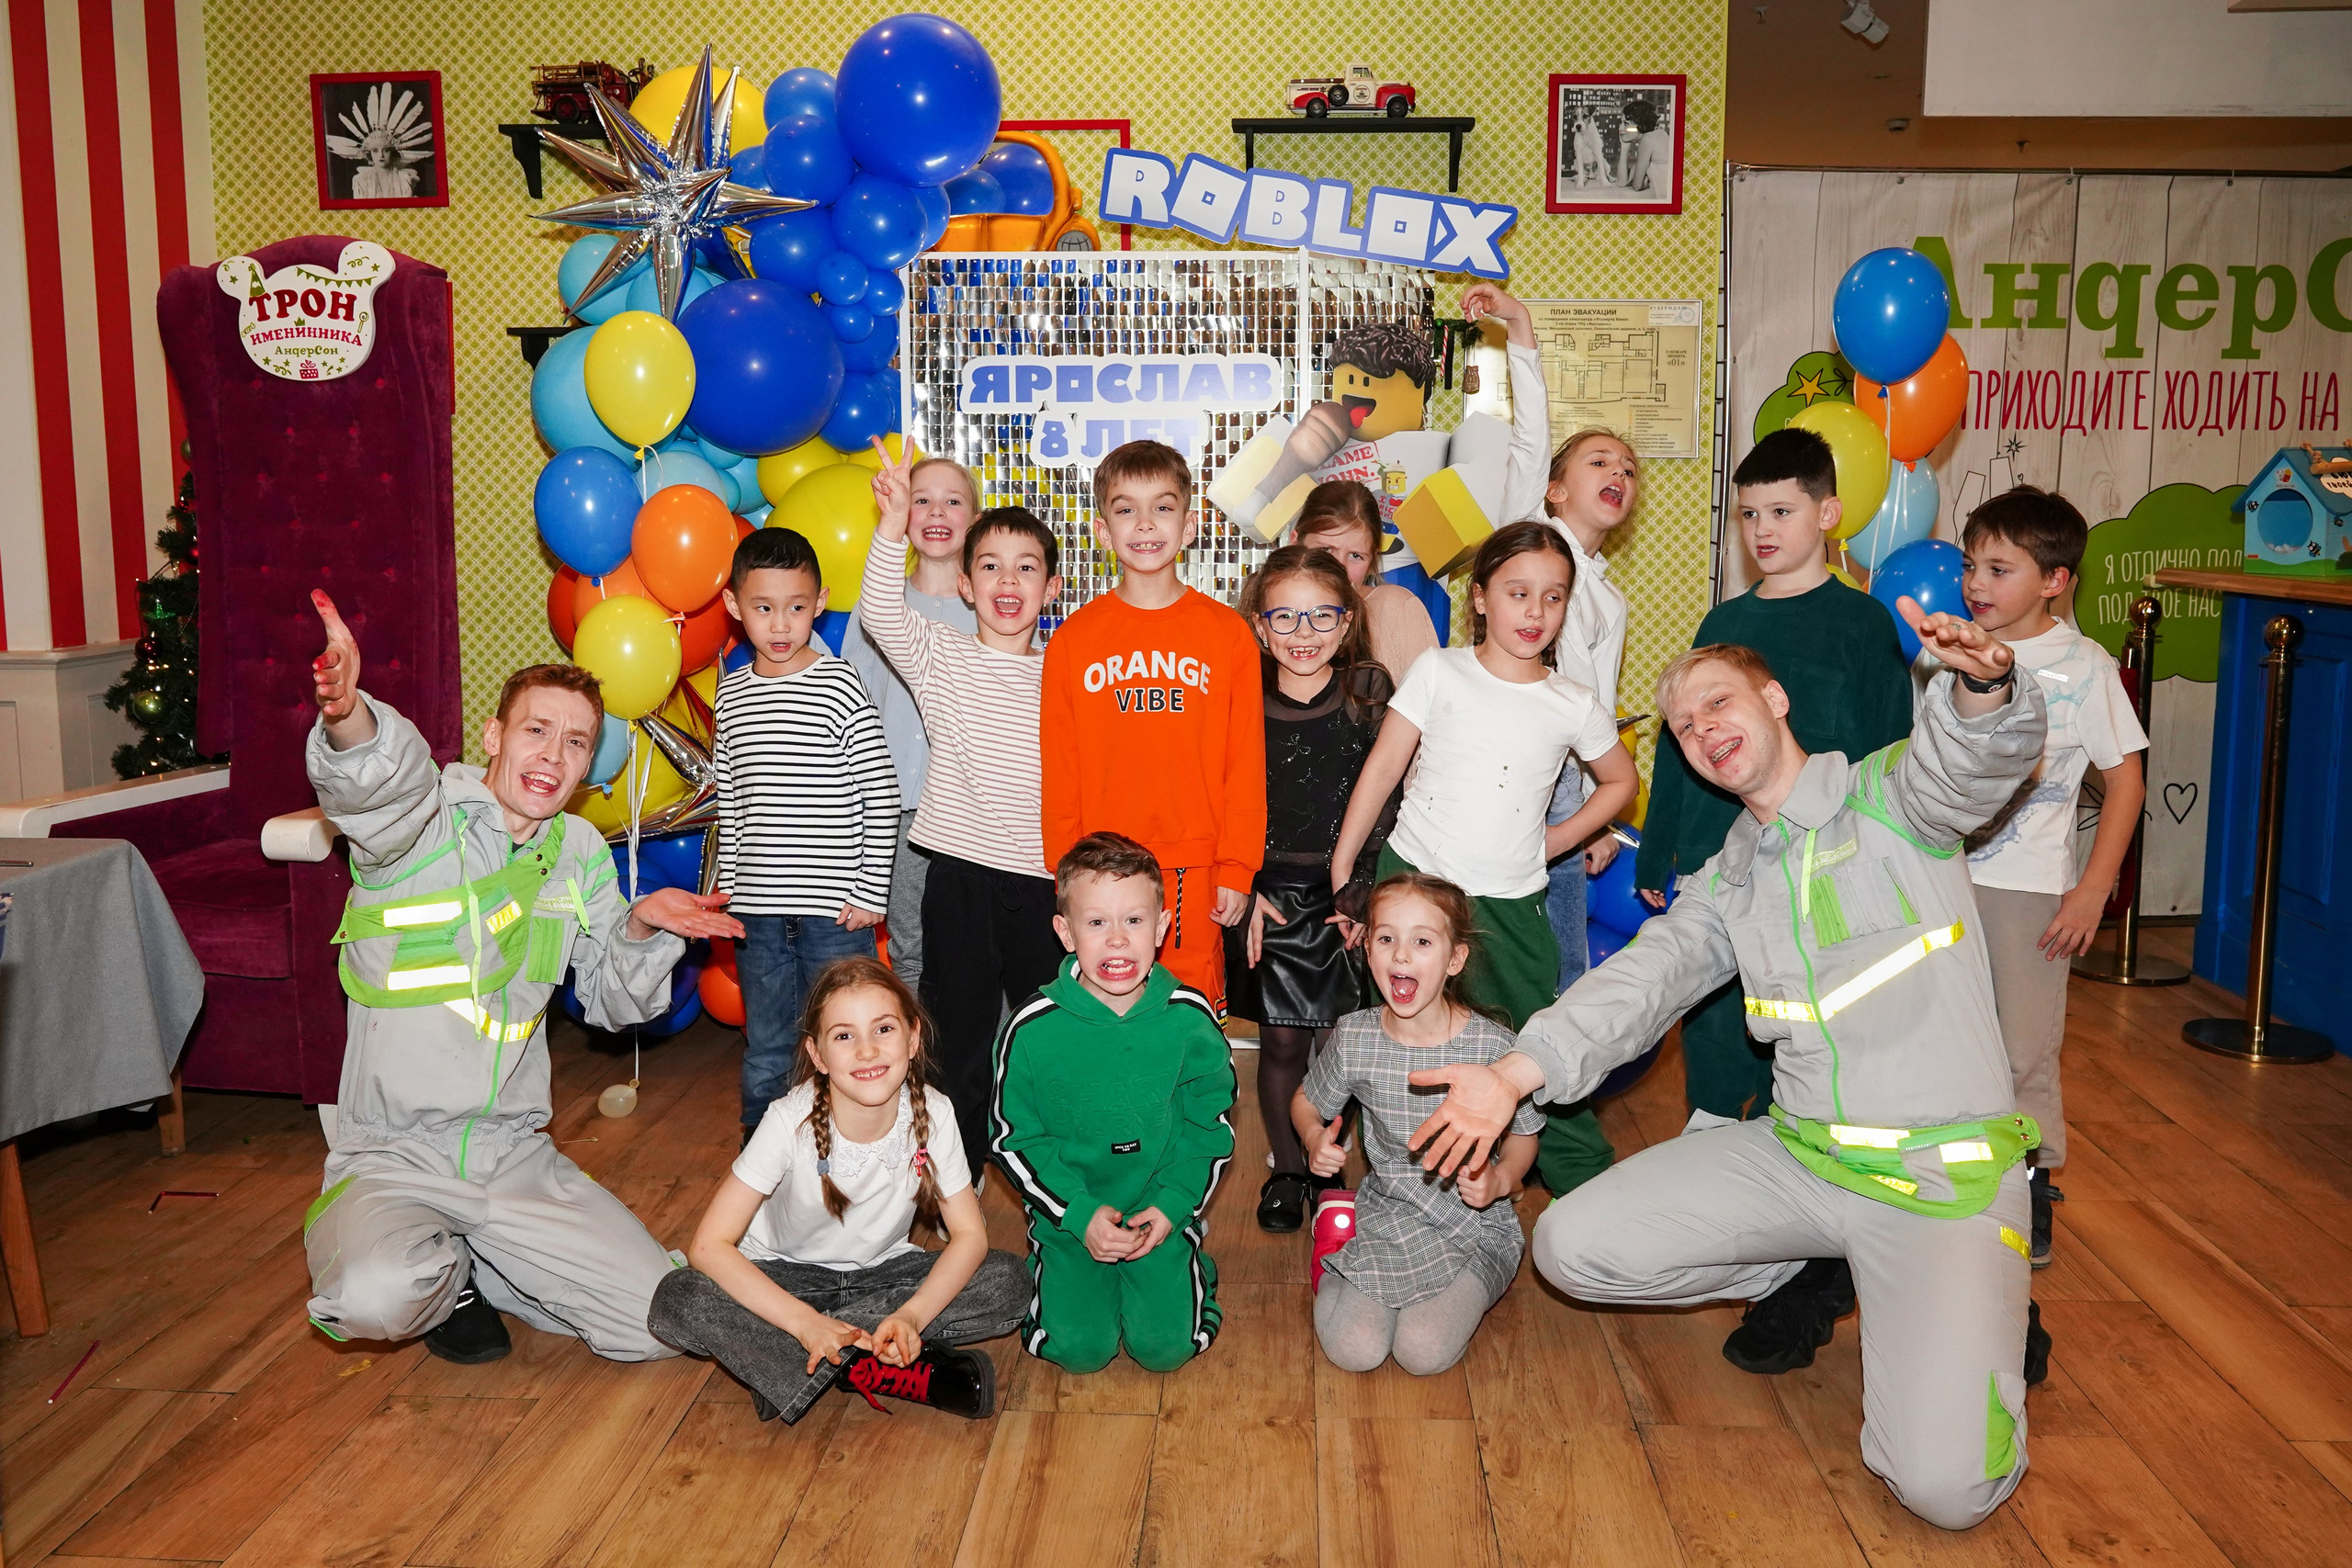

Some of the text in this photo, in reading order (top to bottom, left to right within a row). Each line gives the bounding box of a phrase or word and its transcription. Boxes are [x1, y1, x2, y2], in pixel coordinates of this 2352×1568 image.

[1102, 151, 1515, 276] ROBLOX
[248, 288, 357, 321] ТРОН
[1572, 309, 1617, 317] ЭВАКУАЦИИ
[250, 326, 364, 346] ИМЕНИННИКА
[968, 362, 1274, 404] ЯРОСЛАВ
[1961, 369, 2340, 437] ПРИХОДИТЕ ХОДИТЬ НА
[1039, 419, 1200, 459] 8 ЛЕТ
[2104, 554, 2115, 585] Я
[1083, 649, 1211, 695] ORANGE
[1114, 686, 1185, 713] VIBE
